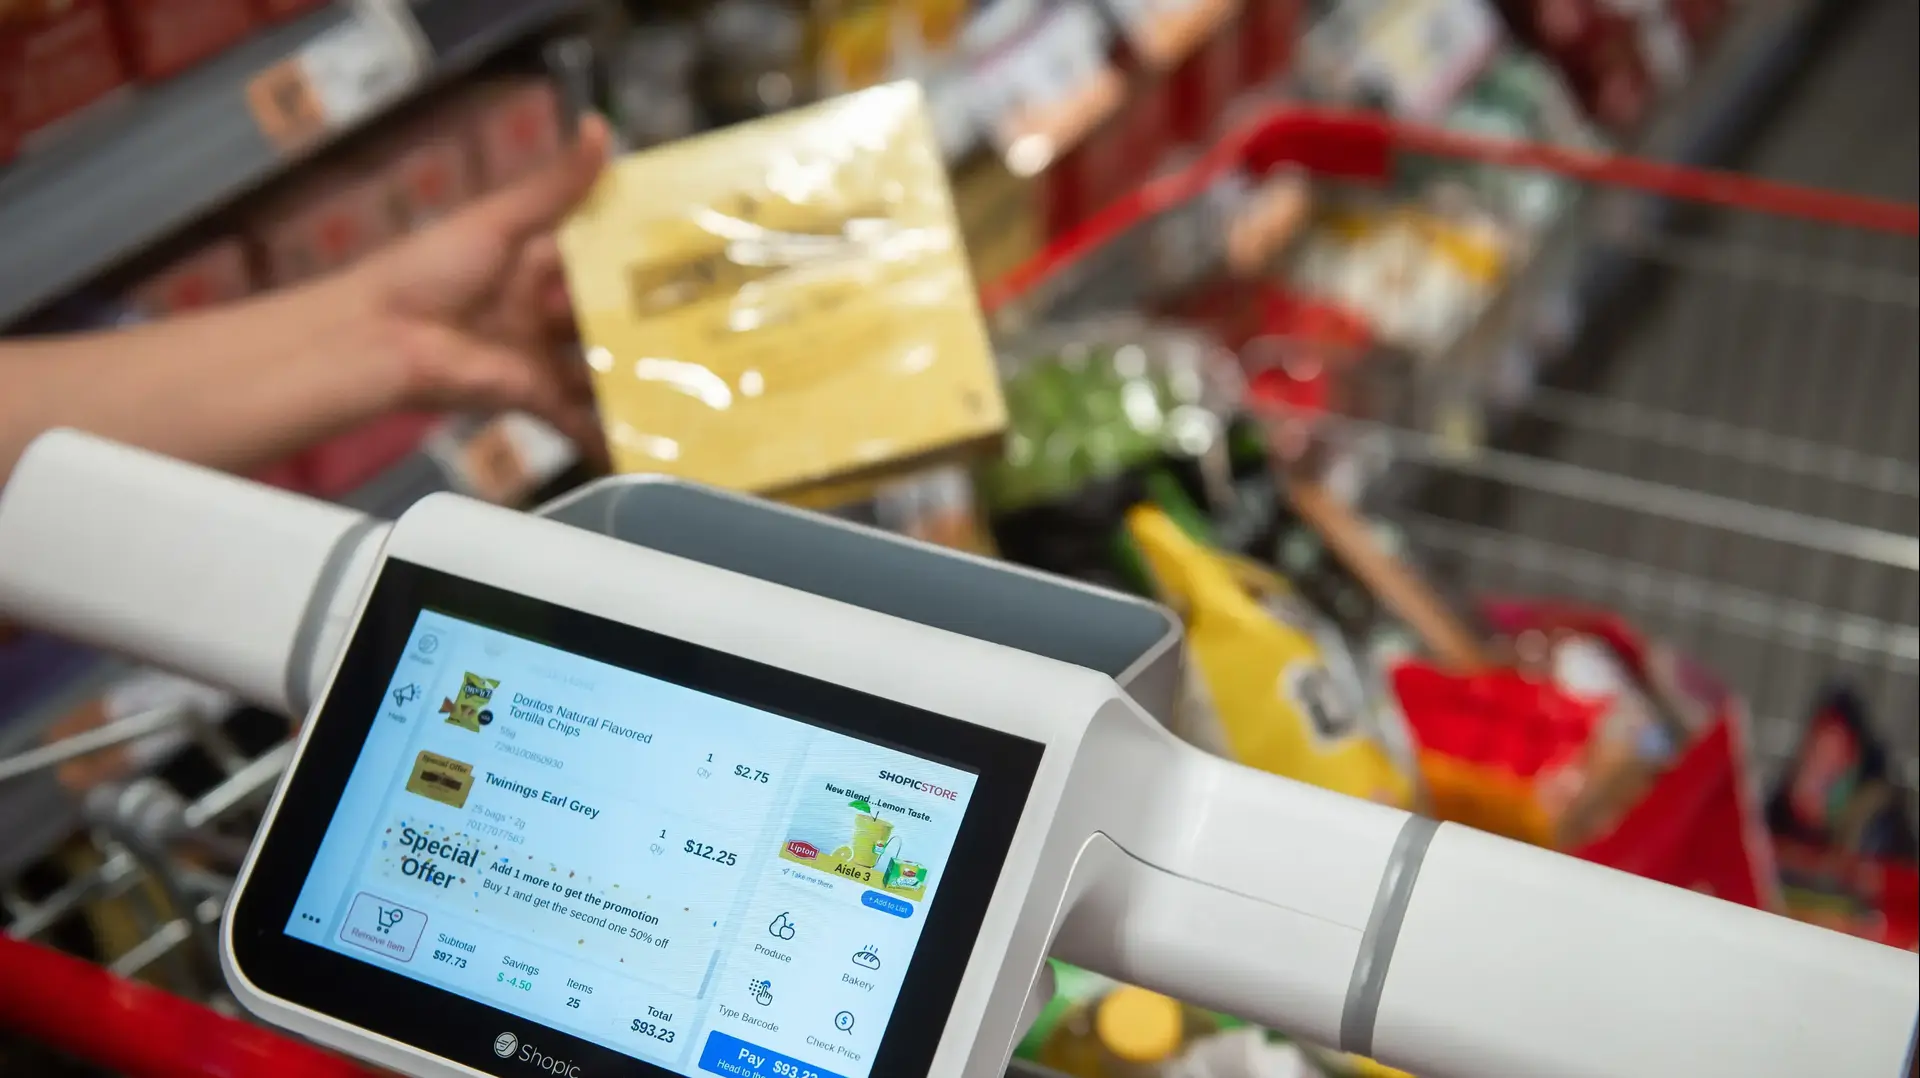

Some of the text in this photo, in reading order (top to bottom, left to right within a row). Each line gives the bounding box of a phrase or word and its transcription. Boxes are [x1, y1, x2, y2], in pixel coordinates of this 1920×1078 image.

[509, 705, 545, 726] Tortilla
[547, 719, 580, 737] Chips
[513, 692, 653, 744] Doritos Natural Flavored
[422, 754, 468, 774] Special Offer
[706, 753, 713, 763] 1
[696, 767, 712, 779] Qty
[734, 764, 770, 784] $2.75
[878, 770, 958, 801] SHOPICSTORE
[485, 772, 538, 799] Twinings
[541, 790, 568, 808] Earl
[569, 800, 600, 820] Grey
[825, 783, 844, 796] New
[907, 808, 933, 823] Taste.
[484, 806, 506, 822] bags
[514, 817, 526, 829] 2g
[659, 829, 667, 839] 1
[399, 827, 480, 868] Special
[650, 843, 665, 856] Qty
[684, 839, 738, 866] $12.25
[789, 842, 816, 858] Lipton
[401, 857, 456, 889] Offer
[791, 870, 805, 880] Take
[816, 878, 834, 889] there
[834, 863, 871, 882] Aisle 3
[490, 861, 659, 926] Add 1 more to get the promotion
[483, 878, 670, 949] Buy 1 and get the second one 50% off
[873, 897, 887, 908] Add
[888, 901, 895, 910] to
[895, 903, 908, 914] List
[351, 926, 406, 953] Remove Item
[437, 933, 477, 953] Subtotal
[433, 950, 467, 969] $97.73
[754, 943, 792, 963] Produce
[502, 955, 540, 976] Savings
[566, 978, 594, 995] Items
[841, 973, 875, 992] Bakery
[566, 997, 581, 1009] 25
[647, 1005, 673, 1022] Total
[718, 1004, 779, 1033] Type Barcode
[631, 1018, 676, 1044] $93.23
[738, 1048, 765, 1069] Pay
[806, 1036, 861, 1061] Check Price
[518, 1043, 581, 1078] Shopic
[717, 1059, 741, 1074] Head
[741, 1067, 751, 1077] to
